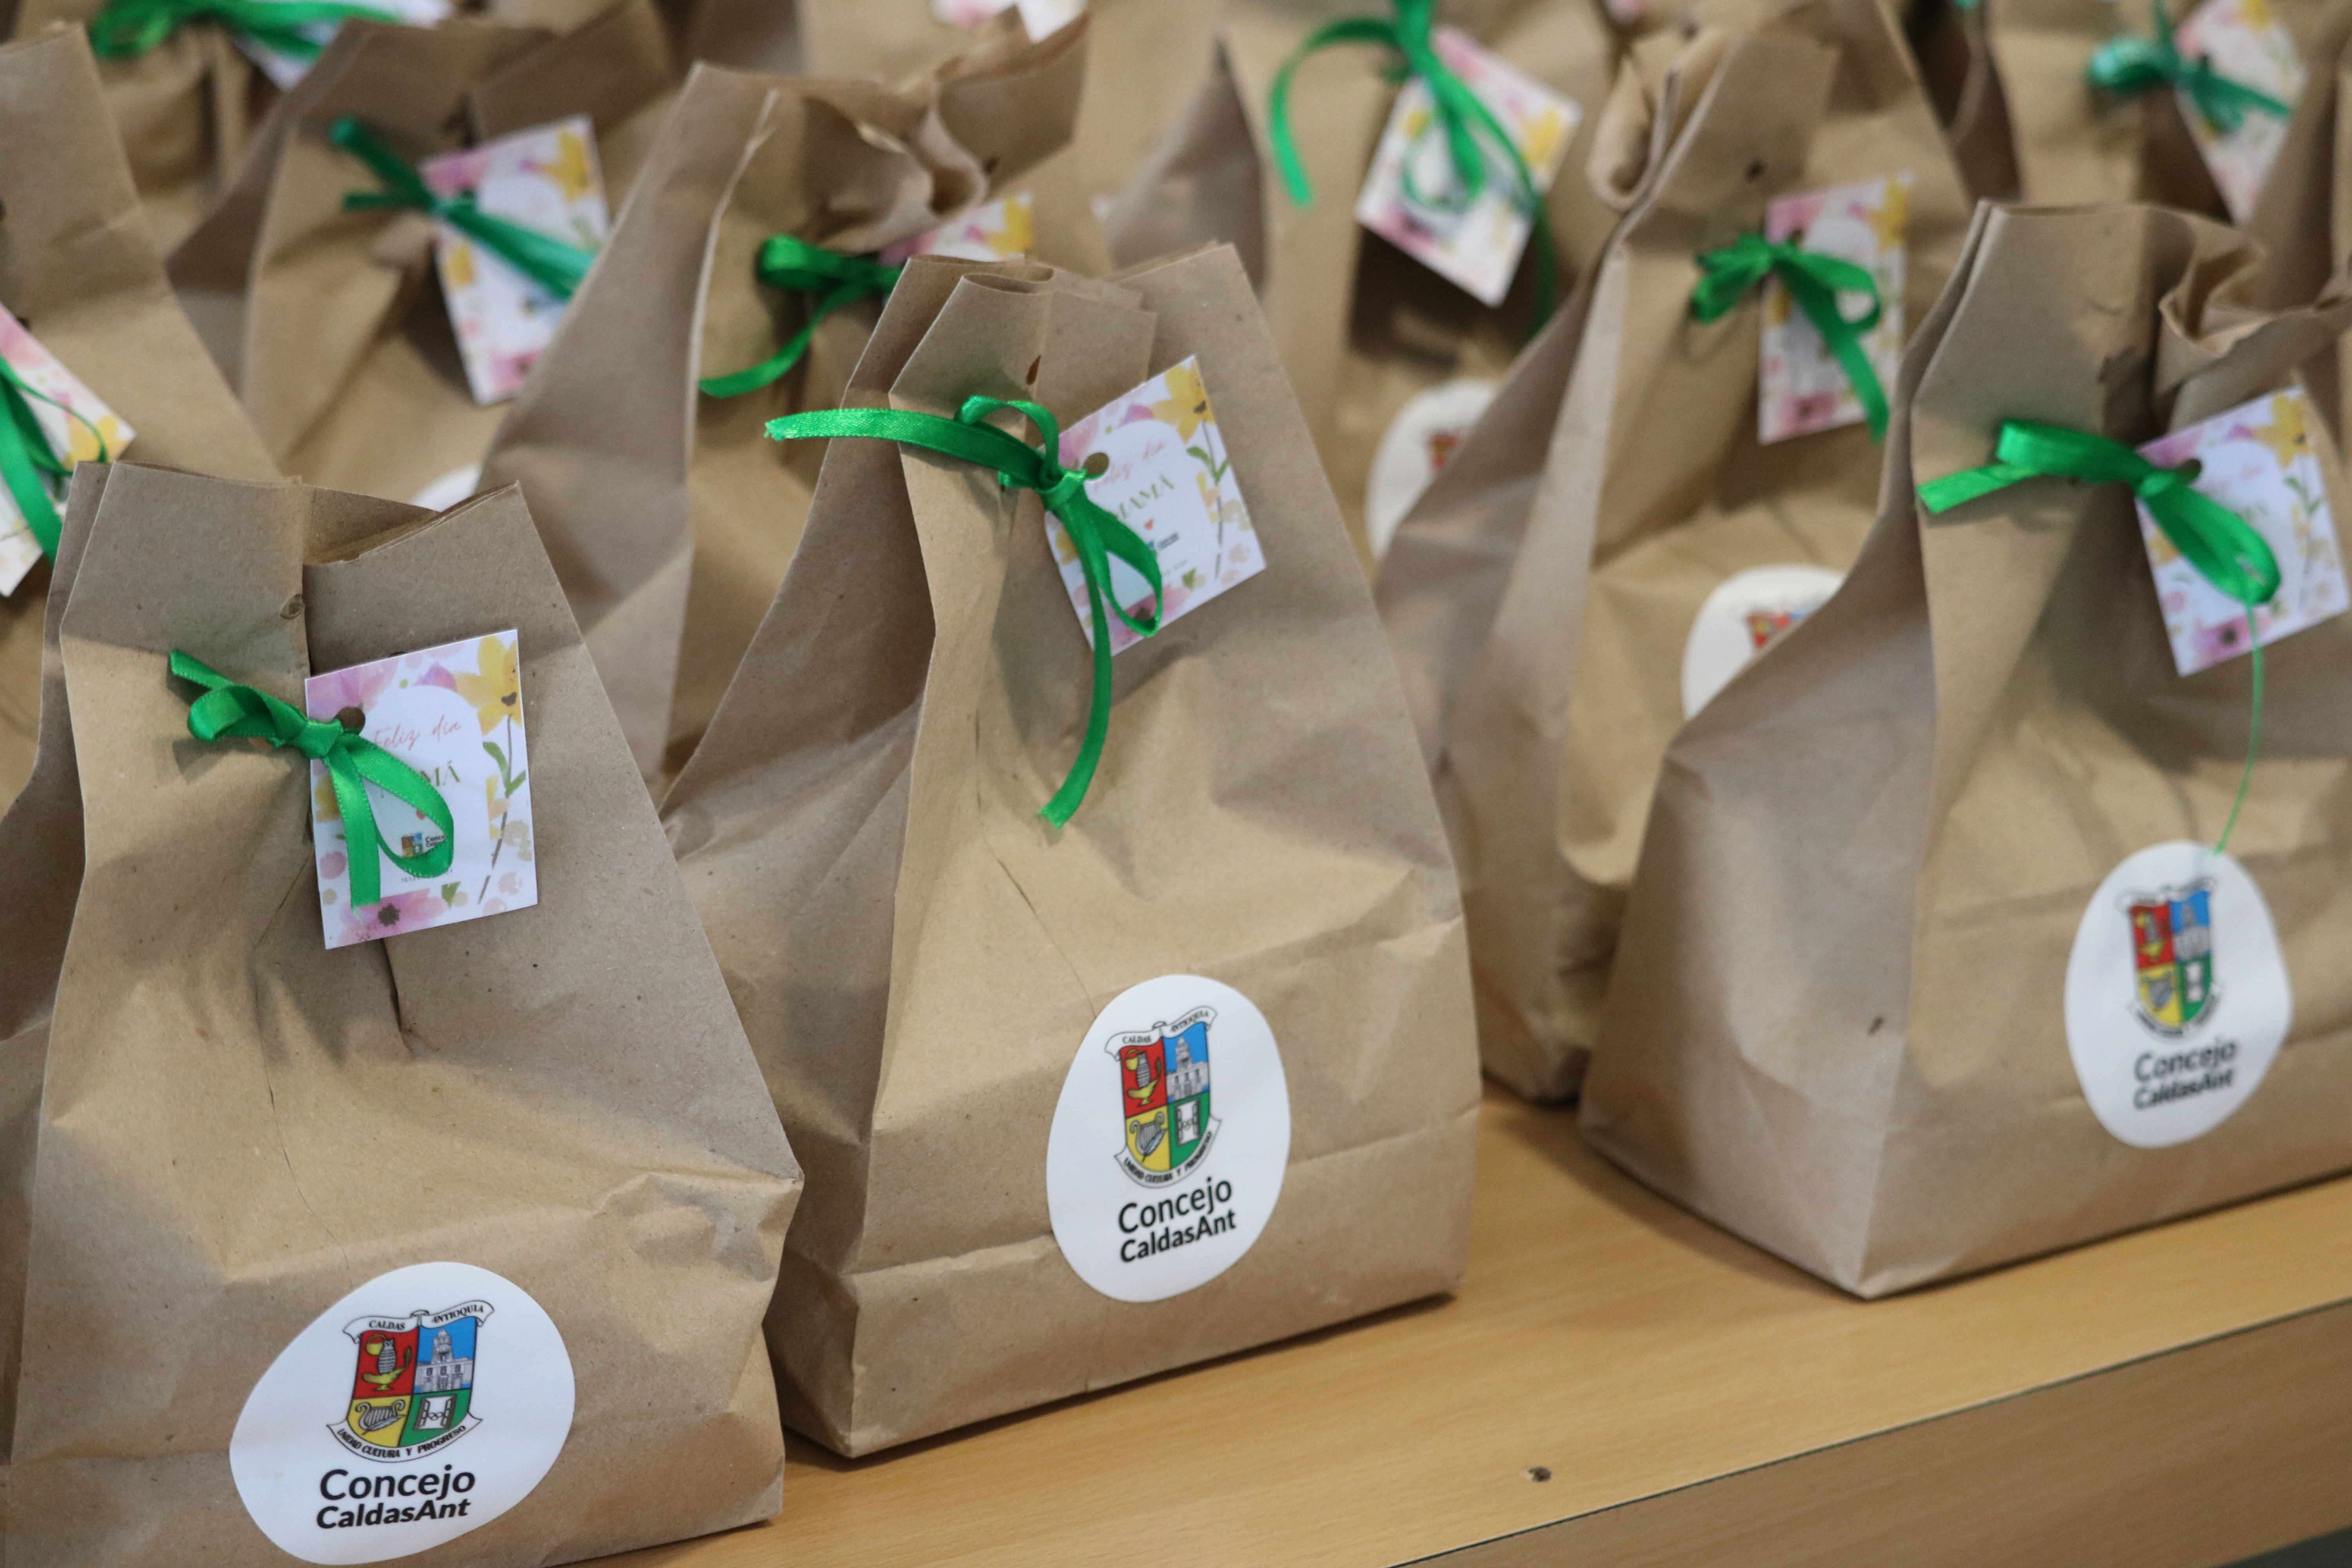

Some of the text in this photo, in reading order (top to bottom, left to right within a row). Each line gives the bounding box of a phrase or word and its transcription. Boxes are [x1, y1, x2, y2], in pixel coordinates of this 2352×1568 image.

[1118, 1176, 1231, 1233] Concejo
[1120, 1209, 1236, 1263] CaldasAnt
[368, 1304, 484, 1330] CALDAS ANTIOQUIA
[405, 1448, 413, 1456] Y
[417, 1425, 466, 1454] PROGRESO
[320, 1464, 475, 1501] Concejo
[317, 1499, 471, 1529] CaldasAnt
